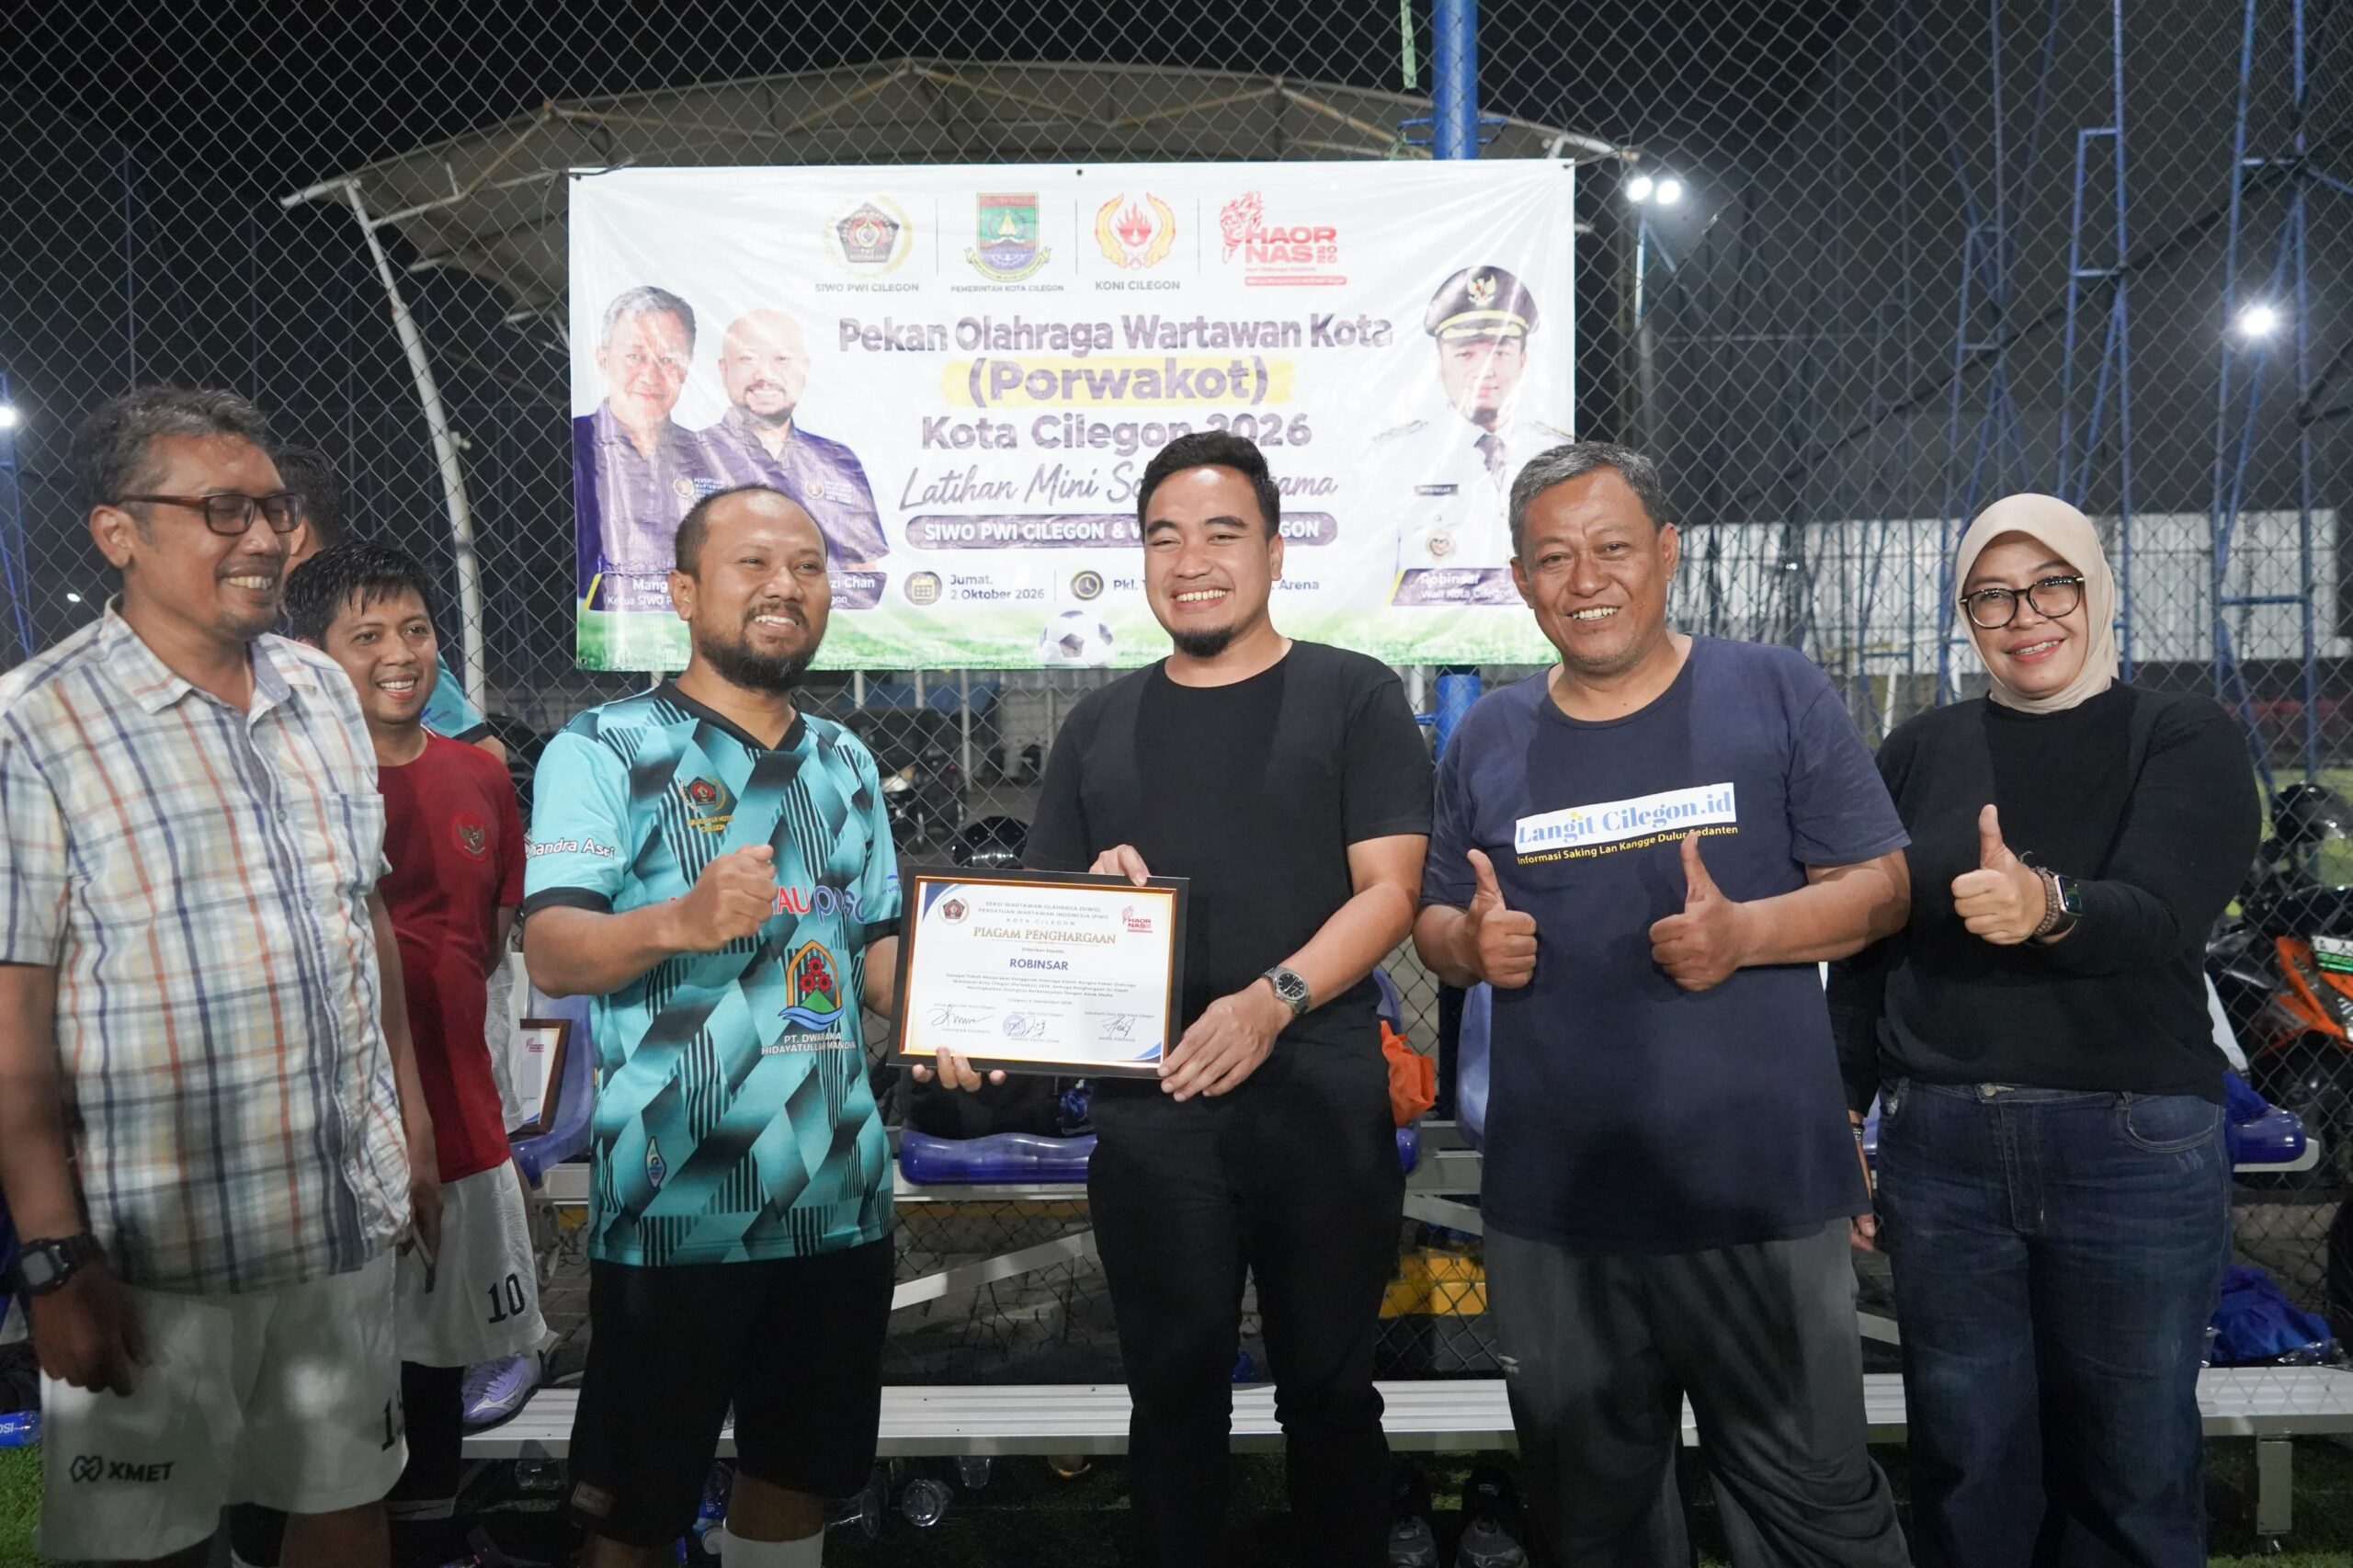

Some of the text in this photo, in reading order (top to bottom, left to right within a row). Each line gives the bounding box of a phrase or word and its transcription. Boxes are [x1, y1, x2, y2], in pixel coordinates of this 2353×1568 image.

[1245, 226, 1336, 244] HAOR
[1245, 245, 1313, 264] NAS
[1316, 245, 1337, 255] 20
[815, 283, 919, 292] SIWO PWI CILEGON
[951, 285, 1003, 293] PEMERINTAH
[1095, 280, 1180, 290] KONI CILEGON
[839, 312, 1392, 358] Pekan Olahraga Wartawan Kota
[968, 355, 1268, 408] (Porwakot)
[922, 415, 1018, 449] Kota
[1031, 412, 1193, 457] Cilegon
[898, 463, 1018, 511] Latihan
[1024, 462, 1099, 506] Mini
[924, 523, 975, 540] SIWO
[981, 523, 1018, 540] PWI
[1021, 521, 1105, 540] CILEGON
[1111, 522, 1126, 539] &
[845, 575, 875, 589] Chan
[1113, 579, 1138, 590] Pkl.
[1279, 579, 1320, 590] Arena
[950, 588, 1045, 600] 2 Oktober 2026
[1518, 790, 1733, 845] Langit Cilegon.id
[581, 837, 616, 860] Asri
[1518, 851, 1562, 866] Informasi
[1563, 847, 1597, 860] Saking
[1599, 844, 1618, 855] Lan
[1620, 836, 1656, 852] Kangge
[1658, 831, 1688, 843] Dulur
[973, 926, 1117, 945] PIAGAM PENGHARGAAN
[1009, 958, 1069, 971] ROBINSAR
[784, 1031, 842, 1043] PT. DWARAKA
[488, 1273, 526, 1324] 10
[108, 1460, 175, 1482] XMET
